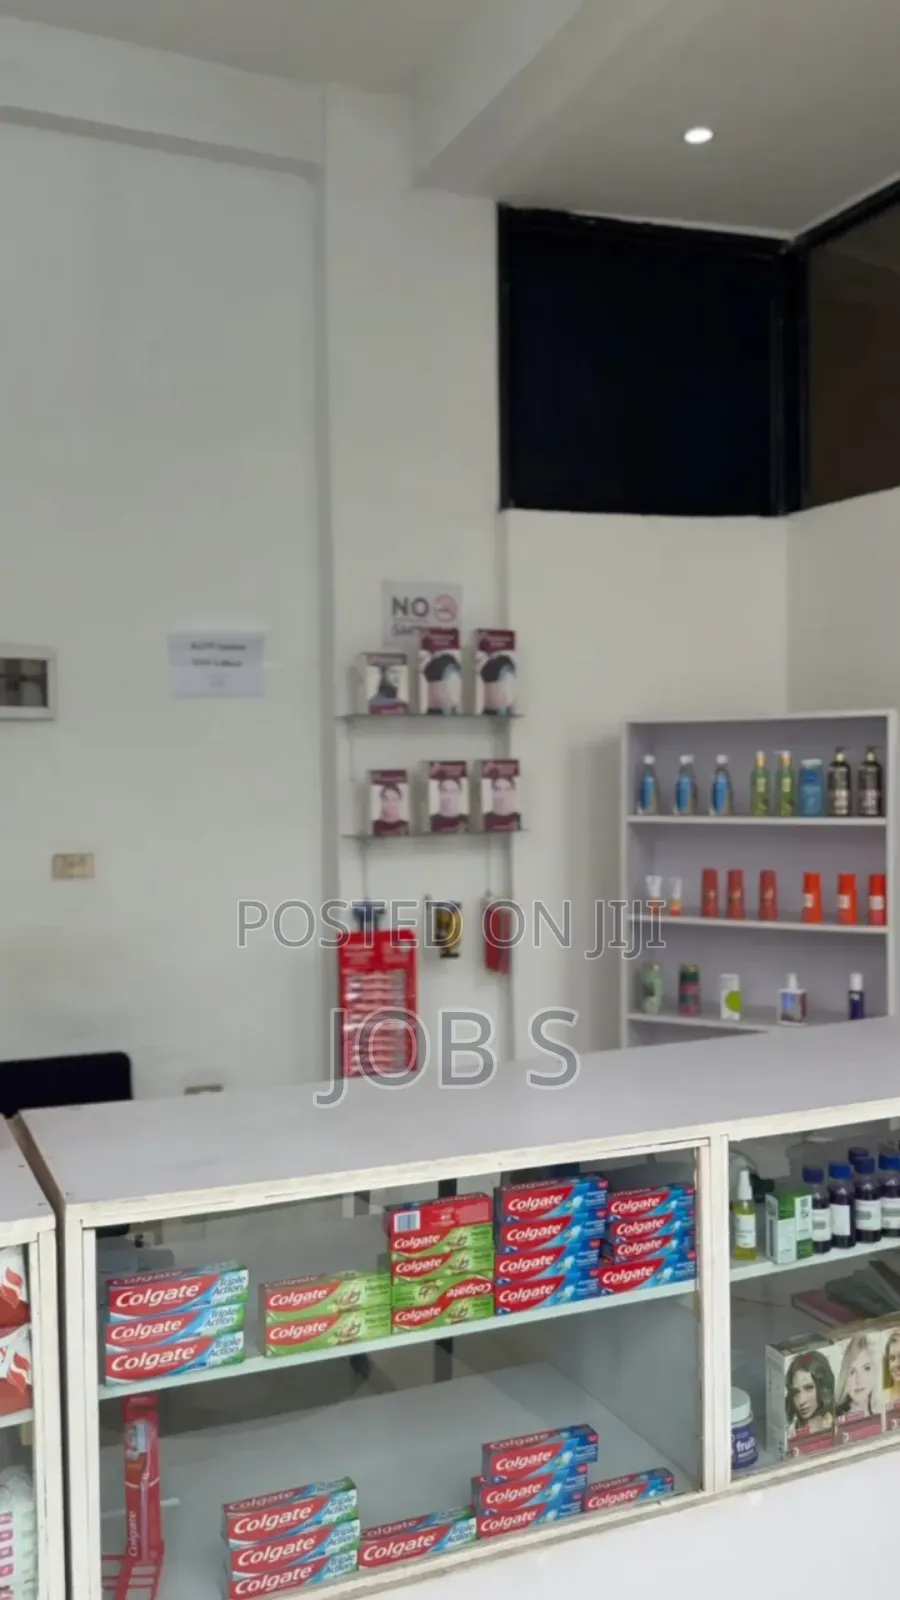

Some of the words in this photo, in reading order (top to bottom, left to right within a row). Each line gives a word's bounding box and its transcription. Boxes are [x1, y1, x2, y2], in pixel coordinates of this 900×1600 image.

[392, 596, 429, 617] NO
[508, 1194, 564, 1212] Colgate
[611, 1196, 661, 1213] Colgate
[507, 1224, 562, 1241] Colgate
[616, 1218, 665, 1235] Colgate
[394, 1234, 441, 1249] Colgate
[617, 1238, 663, 1256] Colgate
[395, 1258, 443, 1273] Colgate
[499, 1254, 555, 1273] Colgate
[602, 1265, 654, 1285] Colgate
[116, 1283, 200, 1307] Colgate
[212, 1285, 244, 1296] Action
[269, 1288, 329, 1307] Colgate
[445, 1283, 492, 1298] Colgate
[499, 1284, 555, 1304] Colgate
[205, 1316, 235, 1327] Action
[394, 1307, 442, 1322] Colgate
[111, 1319, 183, 1340] Colgate
[269, 1321, 329, 1341] Colgate
[111, 1347, 195, 1372] Colgate
[208, 1346, 239, 1357] Action
[496, 1451, 552, 1471] Colgate
[486, 1483, 542, 1504] Colgate
[588, 1488, 639, 1508] Colgate
[234, 1505, 313, 1534] Colgate
[481, 1510, 537, 1532] Colgate
[128, 1511, 137, 1558] Colgate
[237, 1537, 316, 1566] Colgate
[363, 1534, 436, 1561] Colgate
[235, 1565, 313, 1595] Colgate
